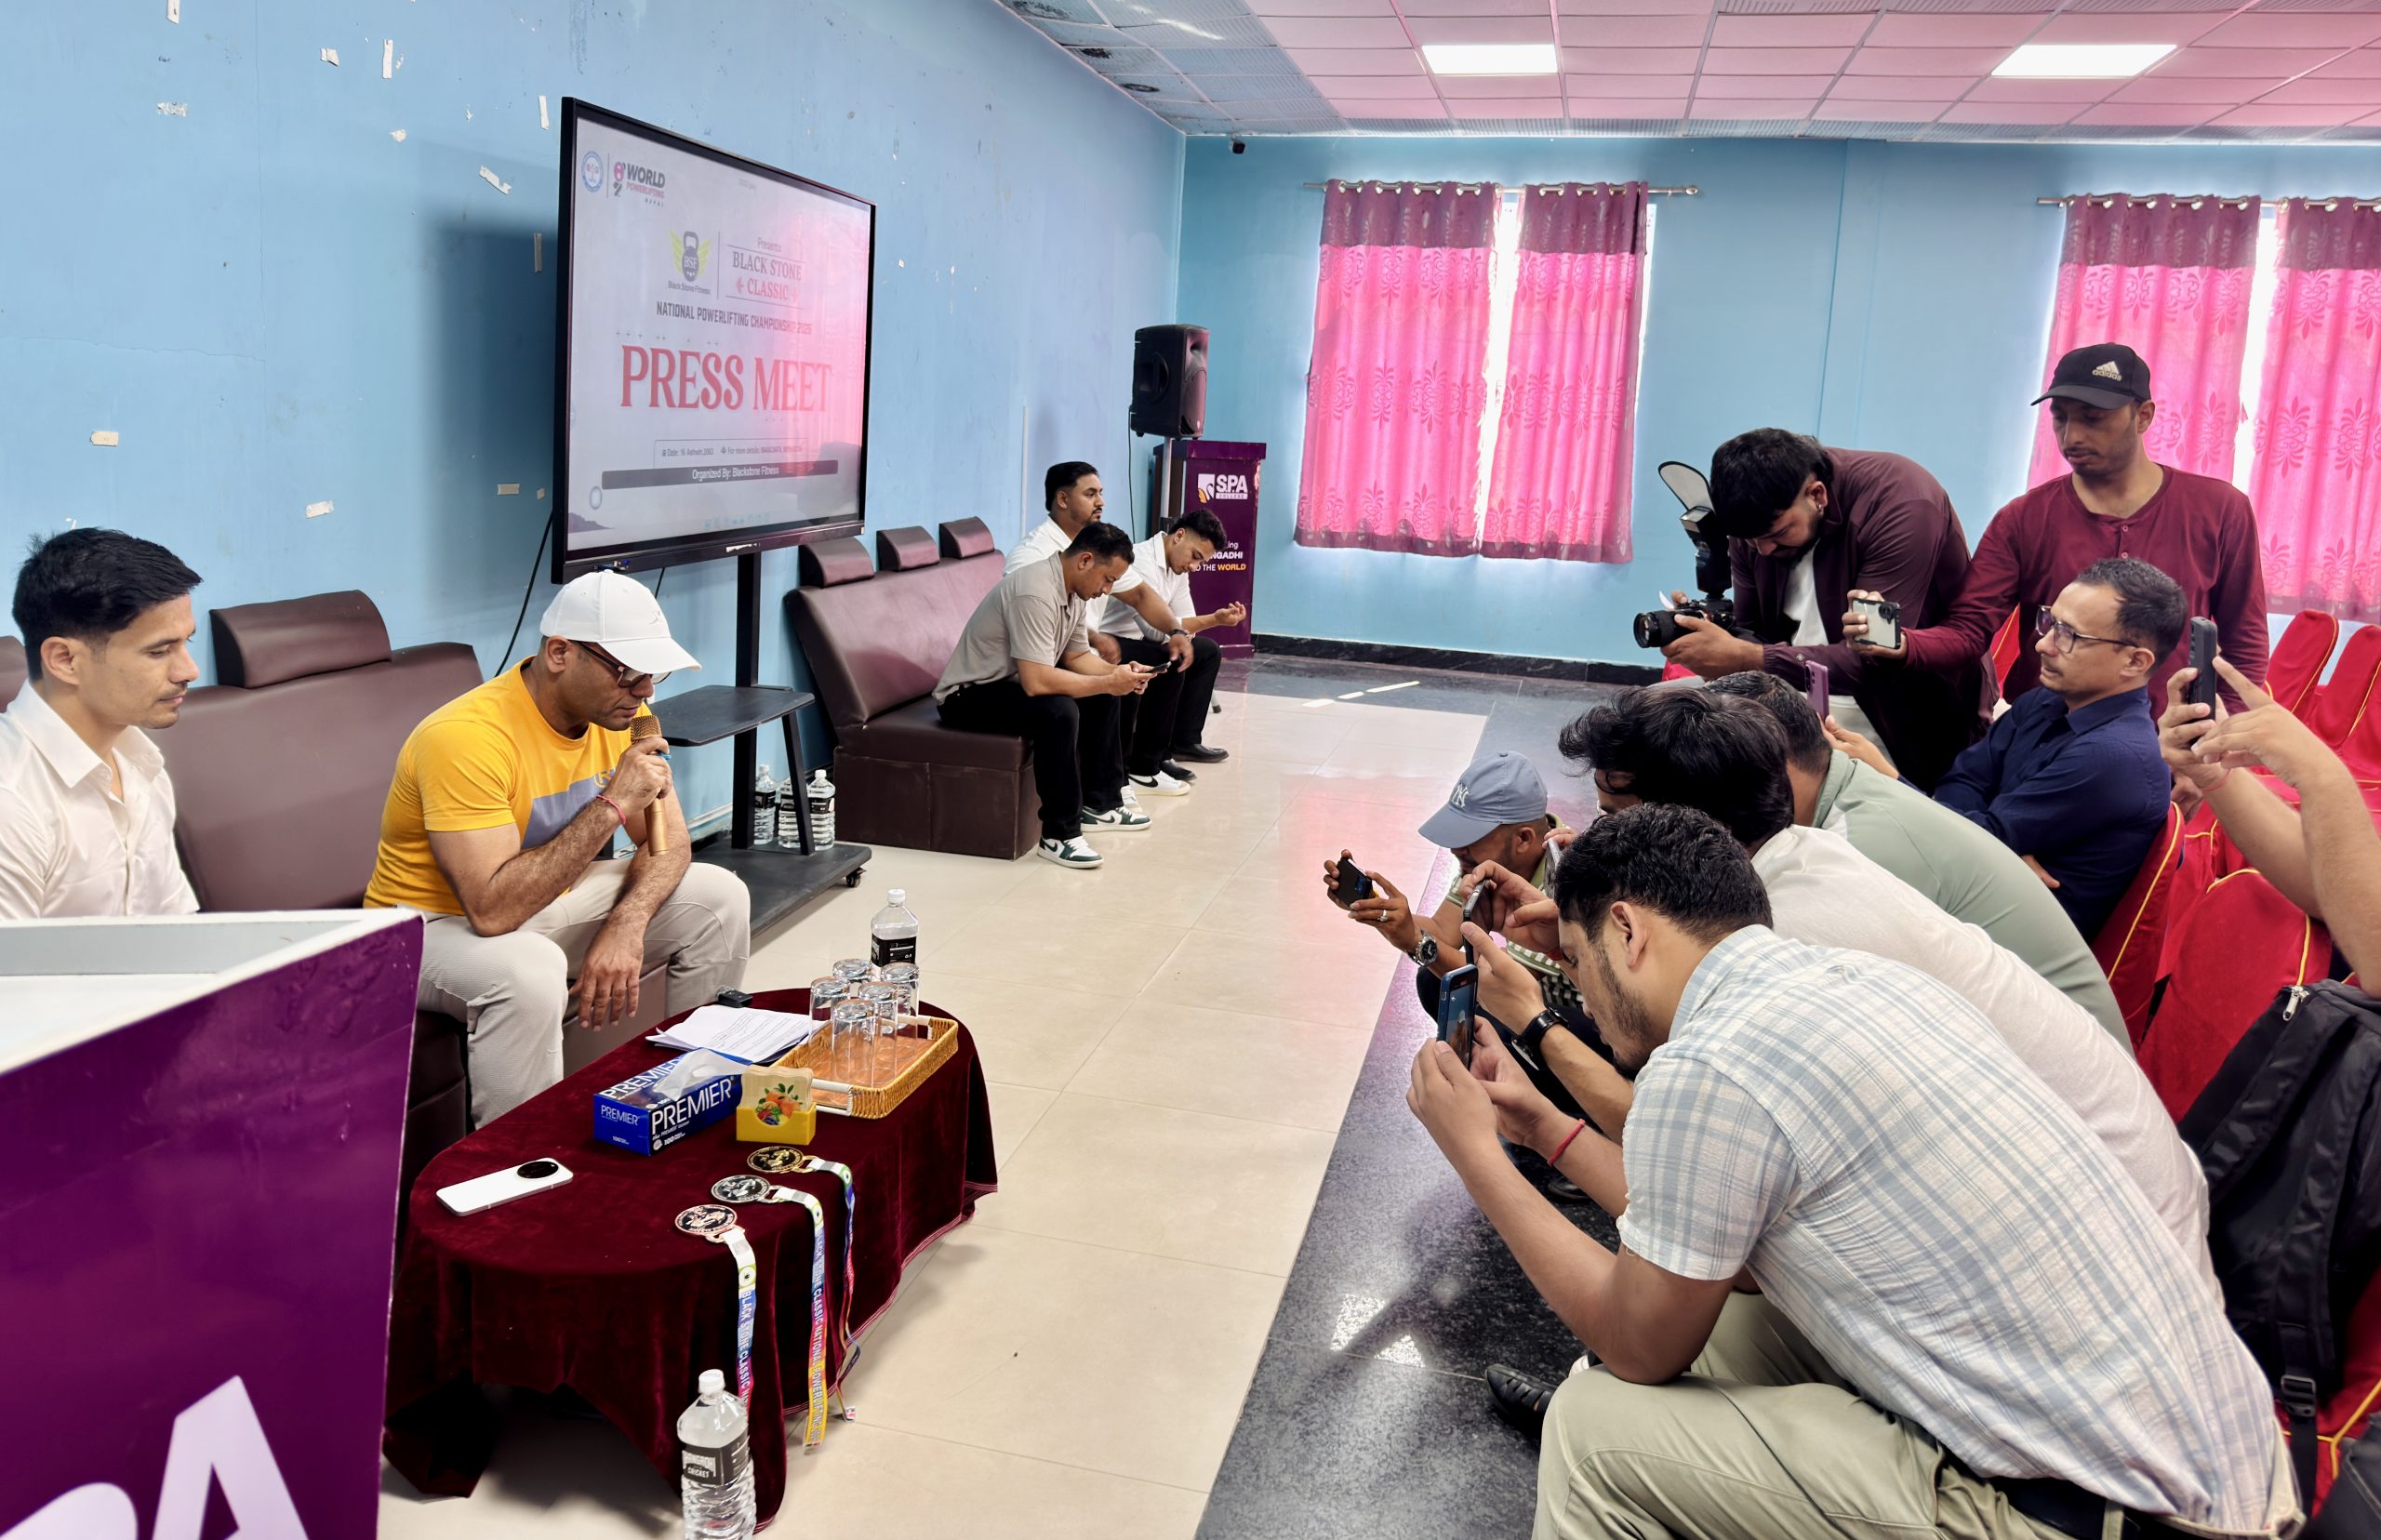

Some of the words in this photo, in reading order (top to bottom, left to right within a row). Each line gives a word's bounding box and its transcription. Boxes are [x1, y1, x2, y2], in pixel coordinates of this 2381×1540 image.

[626, 180, 664, 198] POWERLIFTING
[627, 163, 666, 189] WORLD
[684, 256, 698, 270] BSF
[732, 251, 767, 274] BLACK
[769, 259, 802, 281] STONE
[668, 280, 681, 290] Black
[747, 278, 789, 300] CLASSIC
[657, 300, 695, 320] NATIONAL
[698, 307, 749, 326] POWERLIFTING
[751, 314, 796, 333] CHAMPIONSHIP
[620, 344, 744, 411] PRESS
[752, 357, 832, 412] MEET
[2092, 369, 2122, 381] adidas
[692, 469, 721, 482] Organized
[722, 468, 731, 479] By:
[732, 466, 761, 477] Blackstone
[761, 466, 779, 475] Fitness
[601, 1105, 639, 1126] PREMIER
[652, 1079, 732, 1135] PREMIER
[741, 1291, 752, 1321] BLACK
[813, 1288, 824, 1325] CLASSIC
[739, 1321, 751, 1350] STONE
[813, 1325, 823, 1366] NATIONAL
[739, 1350, 751, 1388] CLASSIC
[813, 1367, 823, 1427] POWERLIFTING
[687, 1467, 710, 1479] CRICKET
